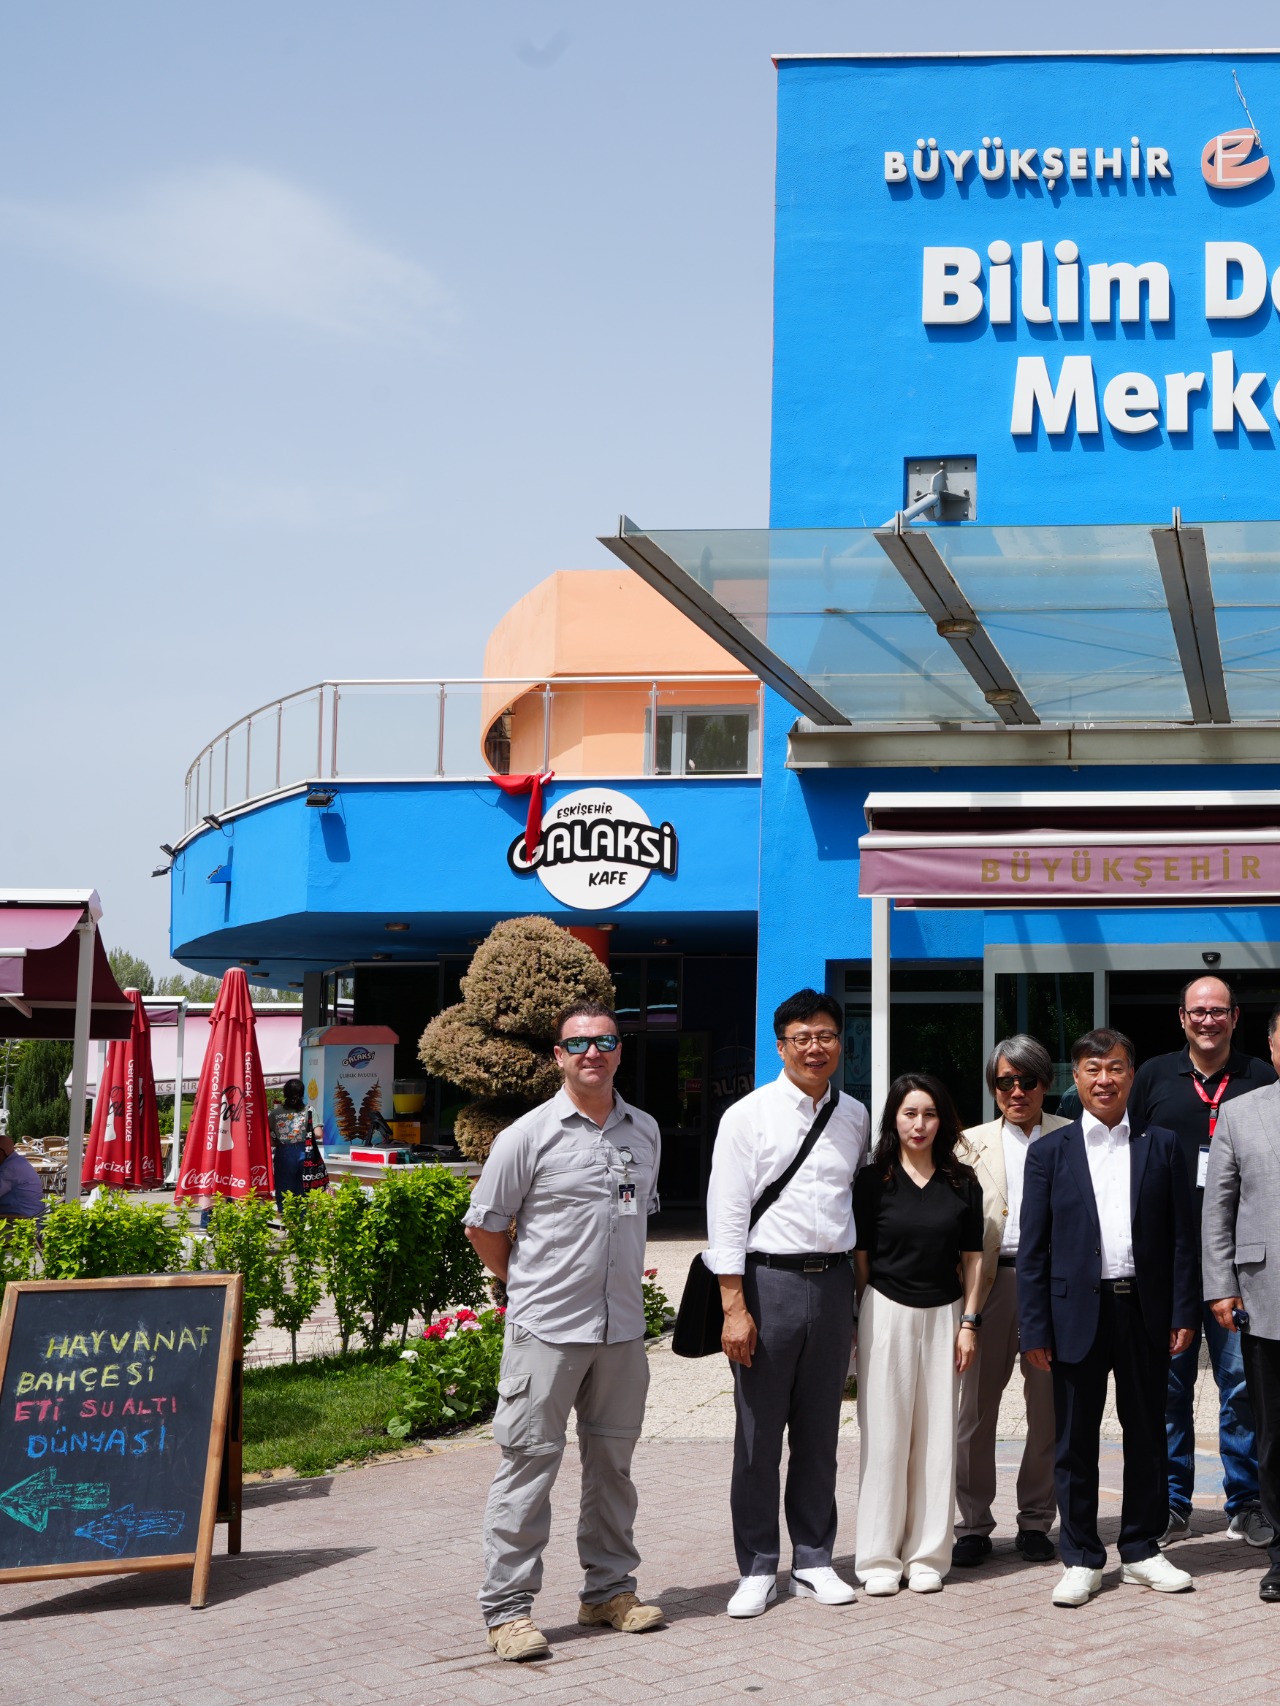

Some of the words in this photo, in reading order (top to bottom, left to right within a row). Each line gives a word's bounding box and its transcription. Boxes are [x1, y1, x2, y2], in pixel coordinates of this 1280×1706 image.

[884, 136, 1172, 191] BÜYÜKŞEHİR
[921, 239, 1171, 326] Bilim
[556, 802, 613, 819] ESKİŞEHİR
[588, 871, 628, 887] KAFE
[980, 848, 1262, 887] BÜYÜKŞEHİR
[46, 1325, 212, 1359] HAYVANAT
[16, 1355, 156, 1396] BAHÇESİ
[14, 1397, 64, 1422] ETİ
[27, 1424, 166, 1459] DÜNYASI
